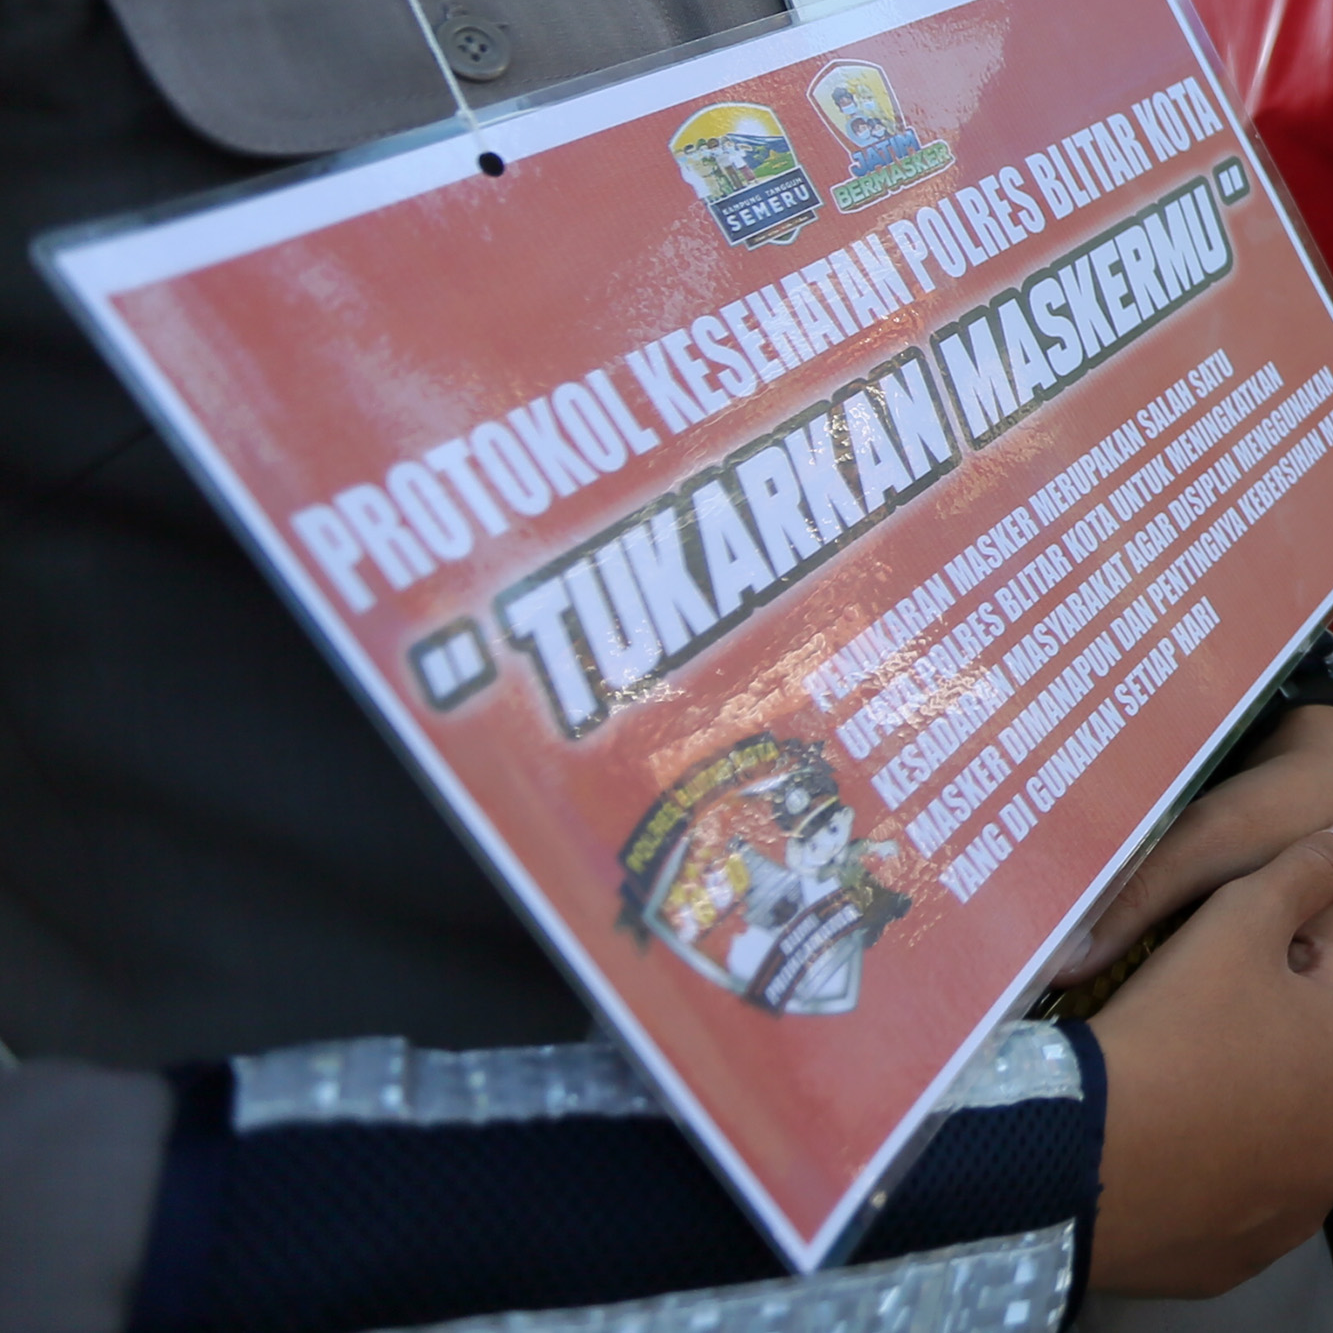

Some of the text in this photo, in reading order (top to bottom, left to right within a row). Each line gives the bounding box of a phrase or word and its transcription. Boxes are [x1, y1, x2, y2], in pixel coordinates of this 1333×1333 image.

[726, 185, 811, 233] SEMERU
[831, 141, 953, 210] BERMASKER
[851, 128, 921, 177] JATIM
[289, 76, 1225, 616] PROTOKOL KESEHATAN POLRES BLITAR KOTA
[802, 347, 1234, 712] PENUKARAN MASKER MERUPAKAN SALAH SATU
[870, 663, 1016, 812] KESADARAN
[1002, 551, 1133, 686] MASYARAKAT
[1124, 511, 1179, 575] AGAR
[1167, 452, 1243, 532] DISIPLIN
[905, 745, 1013, 860] MASKER
[998, 630, 1123, 766] DIMANAPUN
[1109, 594, 1158, 652] DAN
[1146, 506, 1249, 615] PENTINGNYA
[1237, 427, 1328, 525] KEBERSIHAN
[914, 602, 1005, 694] POLRES
[994, 543, 1074, 623] BLITAR
[1061, 503, 1121, 564] KOTA
[1108, 453, 1176, 522] UNTUK
[1164, 360, 1285, 475] MENINGKATKAN
[938, 595, 1222, 905] YANG DI GUNAKAN SETIAP HARI
